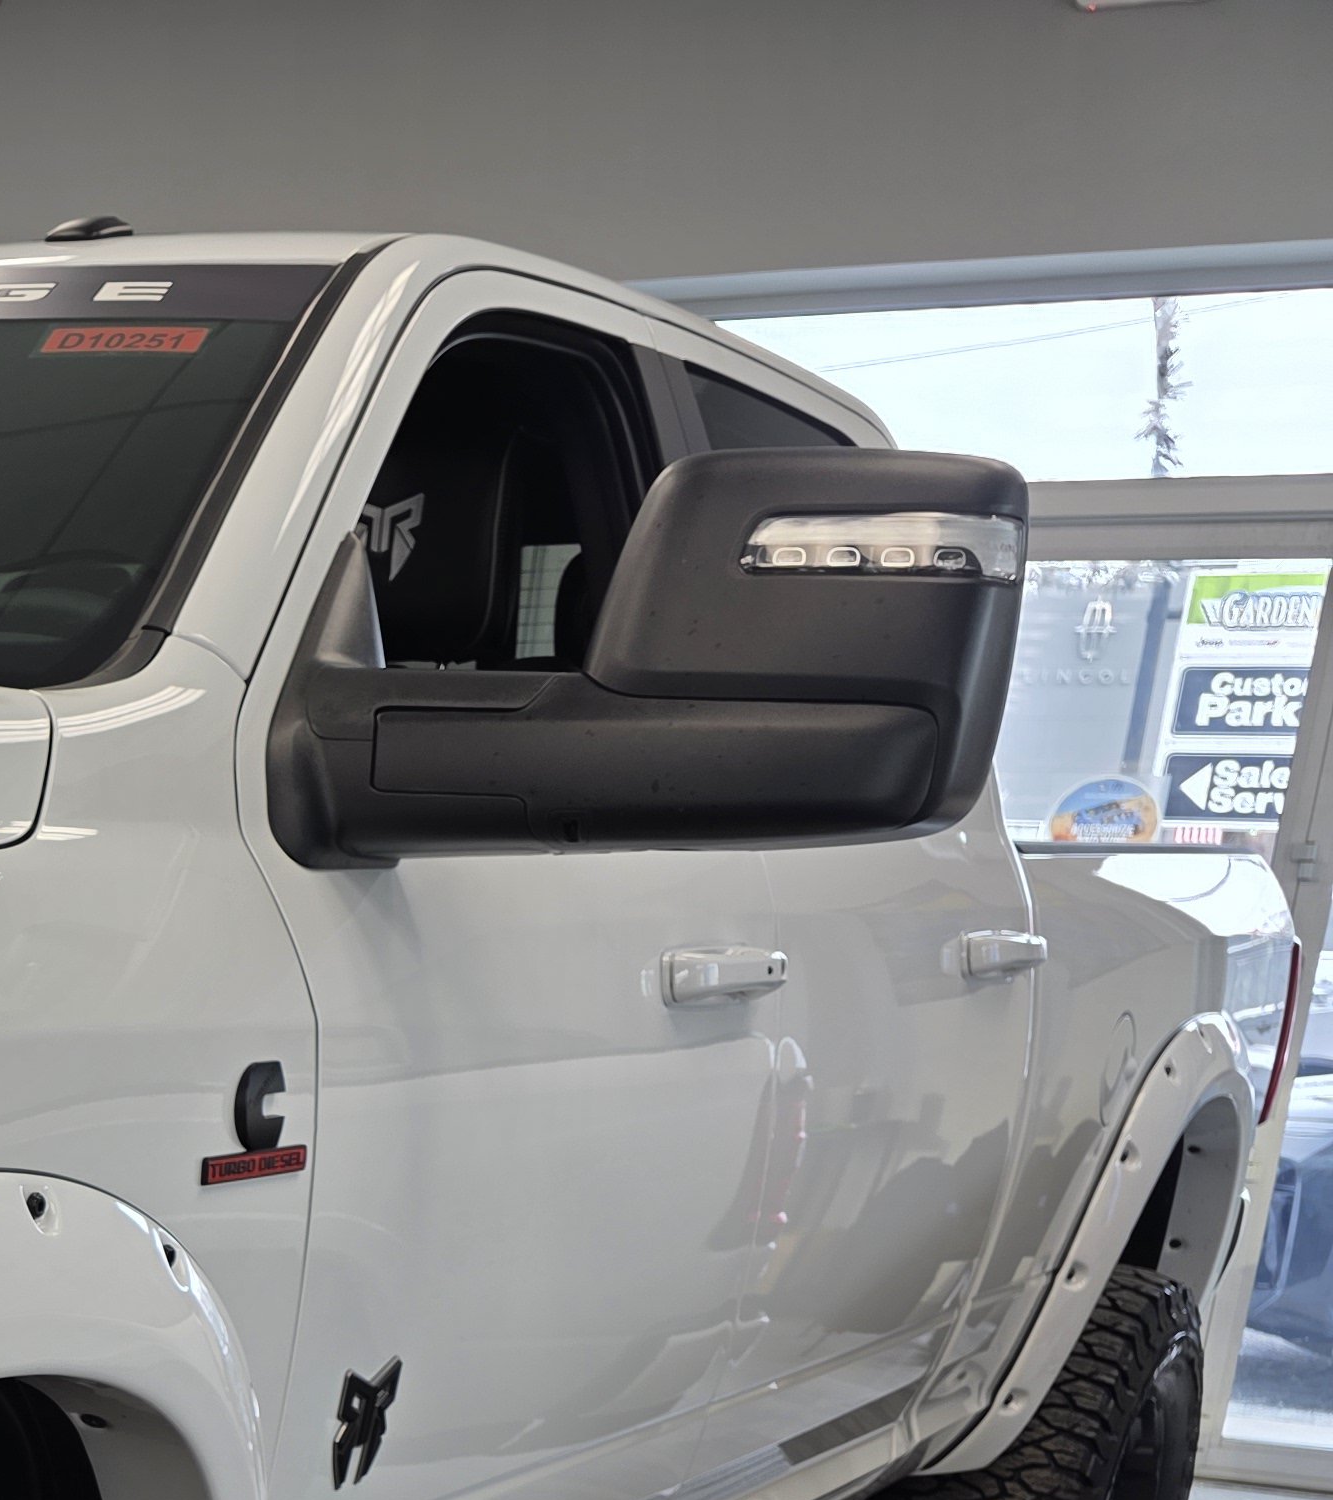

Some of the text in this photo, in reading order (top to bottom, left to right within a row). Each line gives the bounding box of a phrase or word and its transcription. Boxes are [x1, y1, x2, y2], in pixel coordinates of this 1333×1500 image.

[58, 330, 186, 351] D10251
[1221, 590, 1319, 630] GARDEN
[1210, 671, 1309, 697] Custo
[1195, 692, 1303, 727] Park
